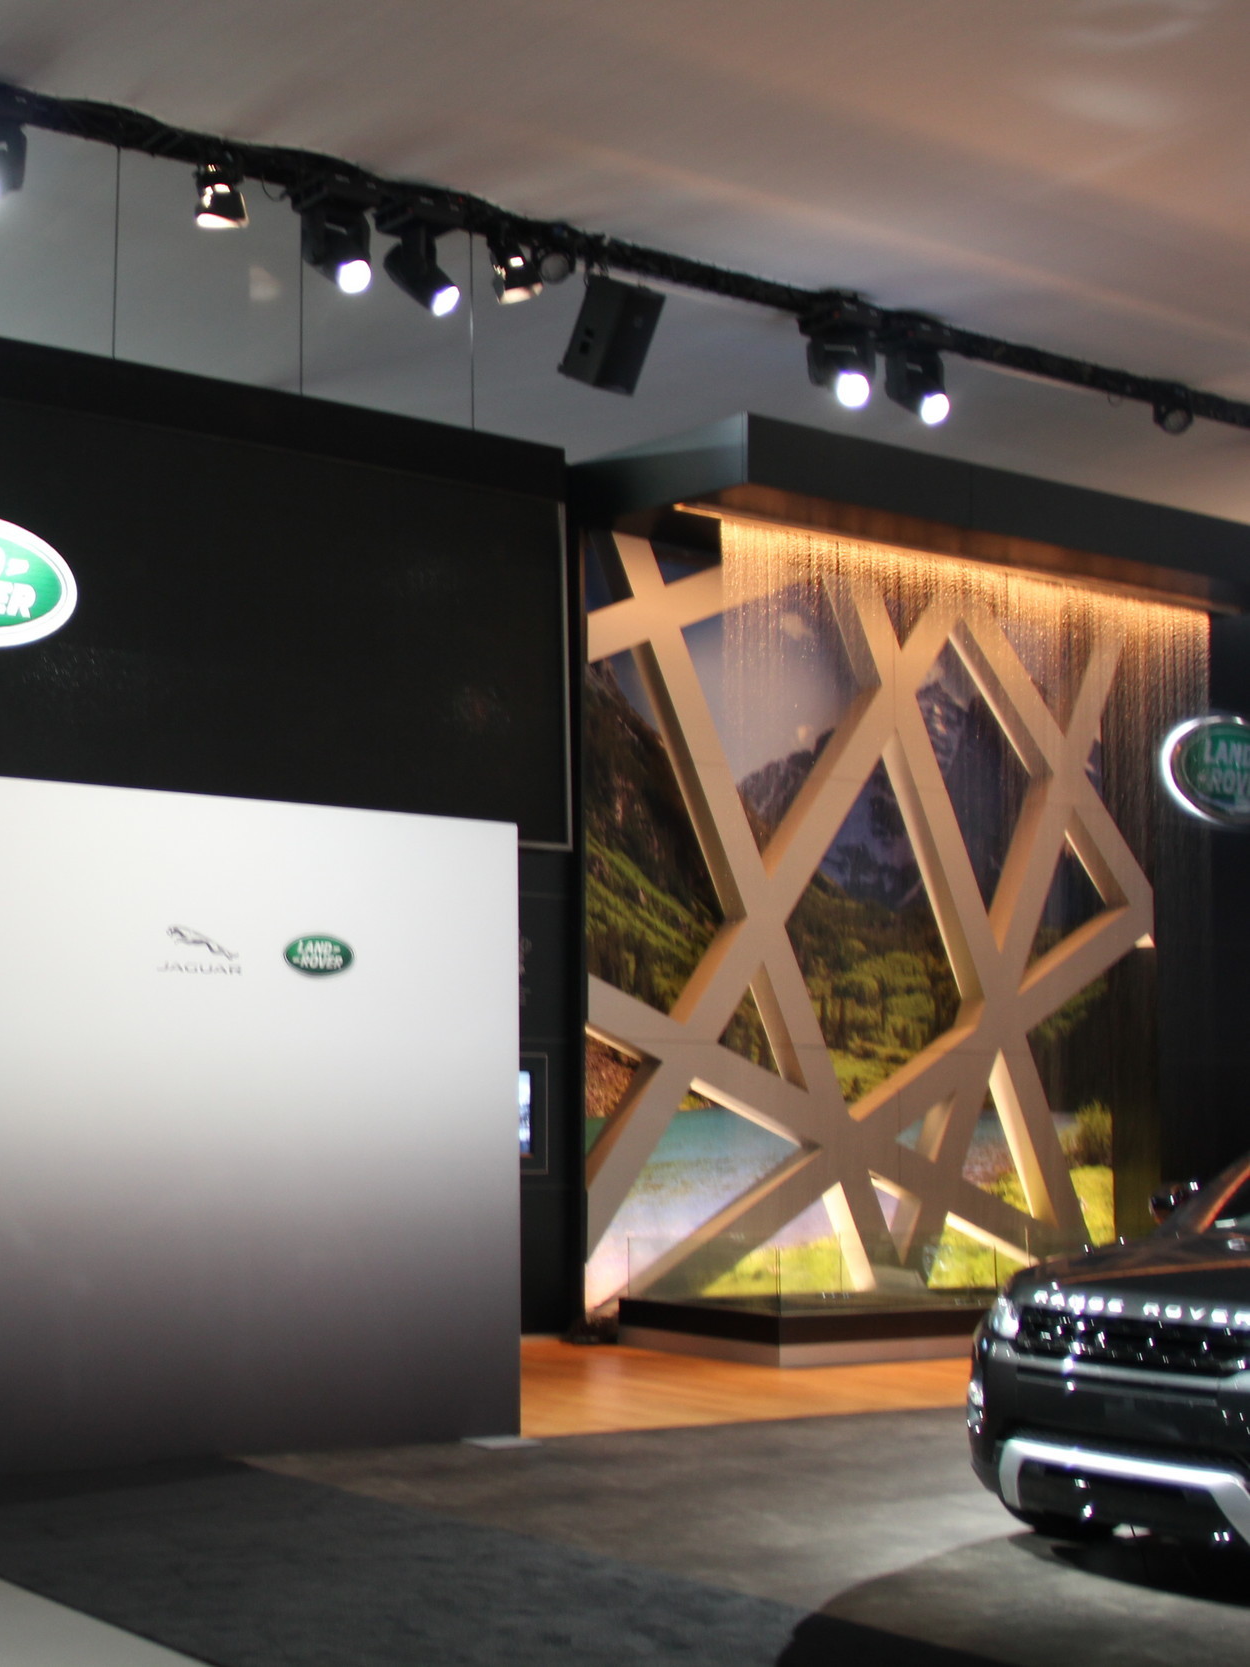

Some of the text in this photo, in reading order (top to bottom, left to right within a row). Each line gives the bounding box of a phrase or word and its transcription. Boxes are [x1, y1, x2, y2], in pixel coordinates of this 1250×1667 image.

[298, 939, 333, 954] LAND
[156, 960, 243, 976] JAGUAR
[300, 953, 344, 969] ROVER
